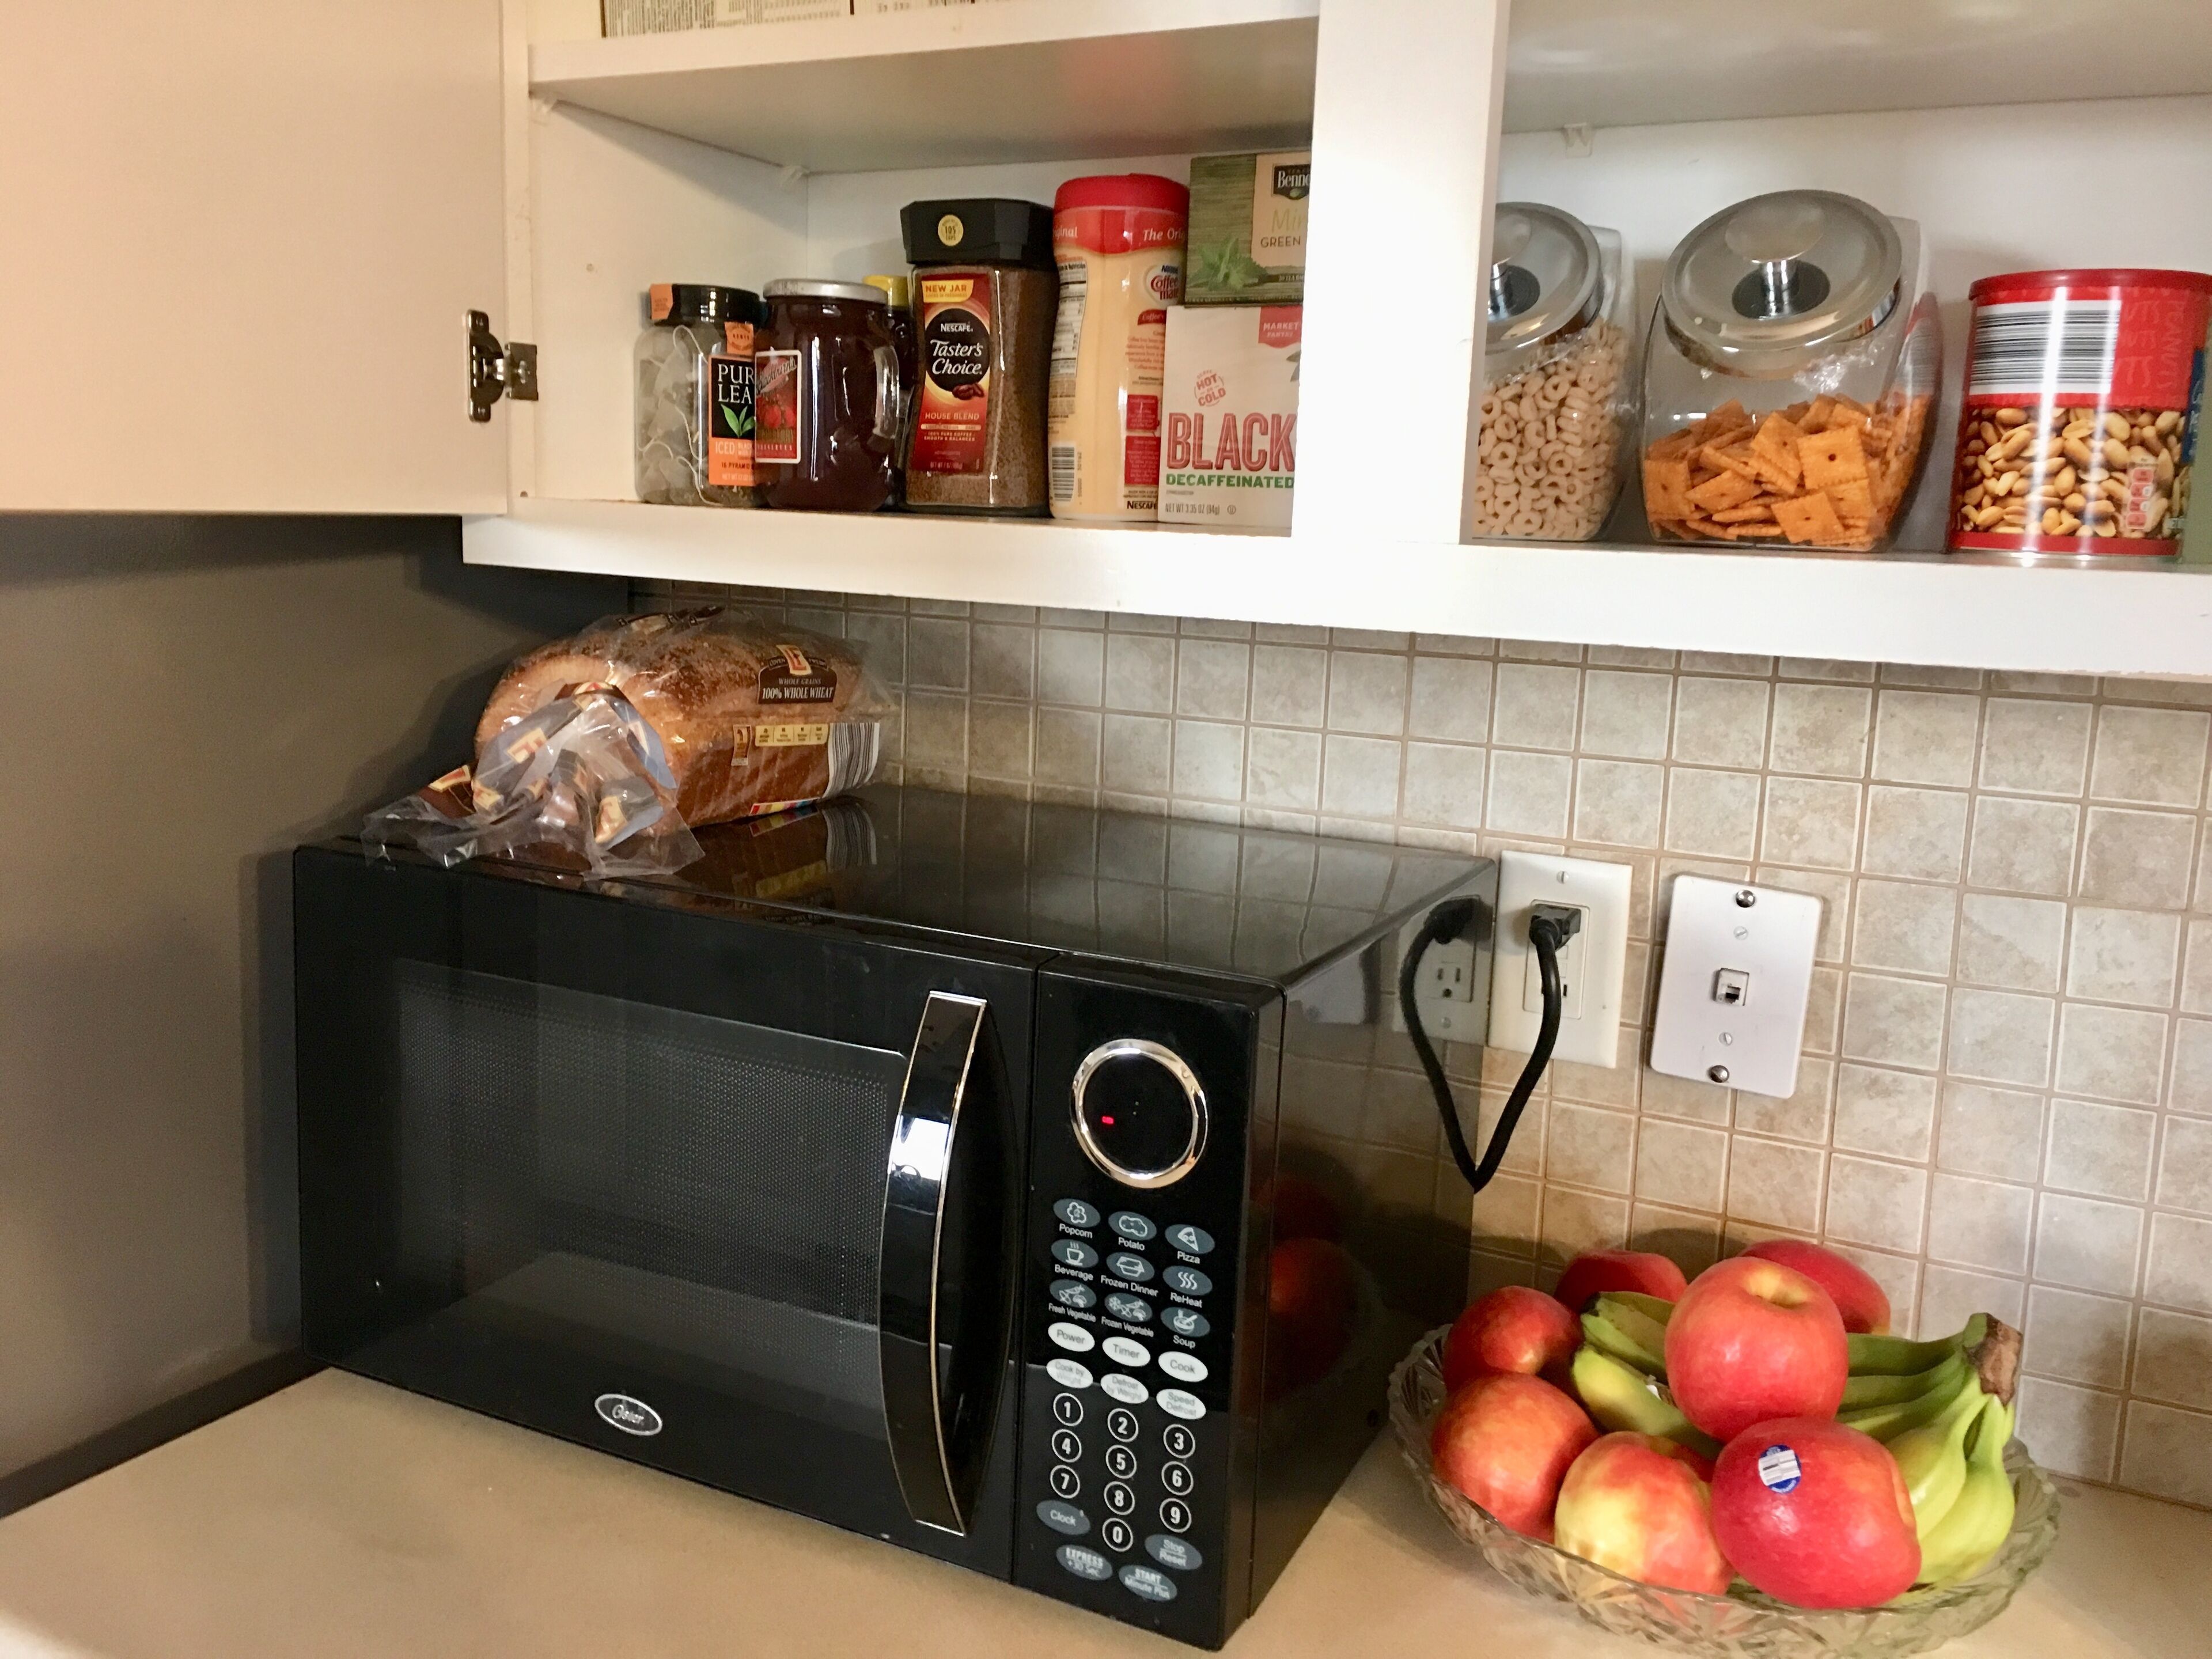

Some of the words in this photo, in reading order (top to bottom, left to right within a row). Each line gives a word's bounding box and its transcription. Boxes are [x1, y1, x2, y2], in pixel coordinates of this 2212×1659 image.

[945, 226, 956, 234] 105
[1143, 228, 1163, 241] The
[1260, 236, 1301, 248] GREEN
[1263, 322, 1299, 331] MARKET
[930, 339, 983, 357] Taster's
[718, 364, 755, 385] PUR
[1196, 373, 1217, 391] HOT
[718, 384, 753, 404] LEA
[1198, 388, 1226, 406] COLD
[925, 412, 950, 420] HOUSE
[715, 441, 735, 454] ICED
[1166, 412, 1297, 472] BLACK
[1166, 474, 1294, 488] DECAFFEINATED
[1165, 503, 1175, 513] NET
[1176, 503, 1184, 513] WT
[1198, 504, 1205, 513] OZ
[762, 688, 782, 699] 100%
[784, 687, 808, 699] WHOLE
[810, 687, 834, 698] WHEAT
[1059, 1224, 1093, 1238] Popcorn
[1118, 1237, 1145, 1251] Potato
[1177, 1251, 1200, 1264] Pizza
[1055, 1264, 1093, 1281] Beverage
[1101, 1275, 1128, 1289] Frozen
[1131, 1282, 1158, 1297] Dinner
[1170, 1292, 1202, 1308] ReHeat
[1048, 1303, 1066, 1314] Fresh
[1101, 1316, 1122, 1329] Frozen
[1056, 1330, 1085, 1344] Power
[1173, 1335, 1195, 1349] Soup
[1112, 1344, 1140, 1358] Timer
[1055, 1361, 1074, 1373] Cook
[1170, 1359, 1195, 1374] Cook
[1168, 1392, 1195, 1407] Speed
[1063, 1401, 1071, 1418] 1
[1118, 1416, 1128, 1434] 2
[1062, 1438, 1071, 1455] 4
[1174, 1432, 1184, 1450] 3
[1116, 1453, 1126, 1470] 5
[1060, 1472, 1070, 1490] 7
[1172, 1469, 1182, 1487] 6
[1114, 1490, 1124, 1508] 8
[1050, 1509, 1076, 1527] Clock
[1170, 1506, 1180, 1524] 9
[1112, 1527, 1123, 1544] 0
[1135, 1569, 1161, 1584] START
